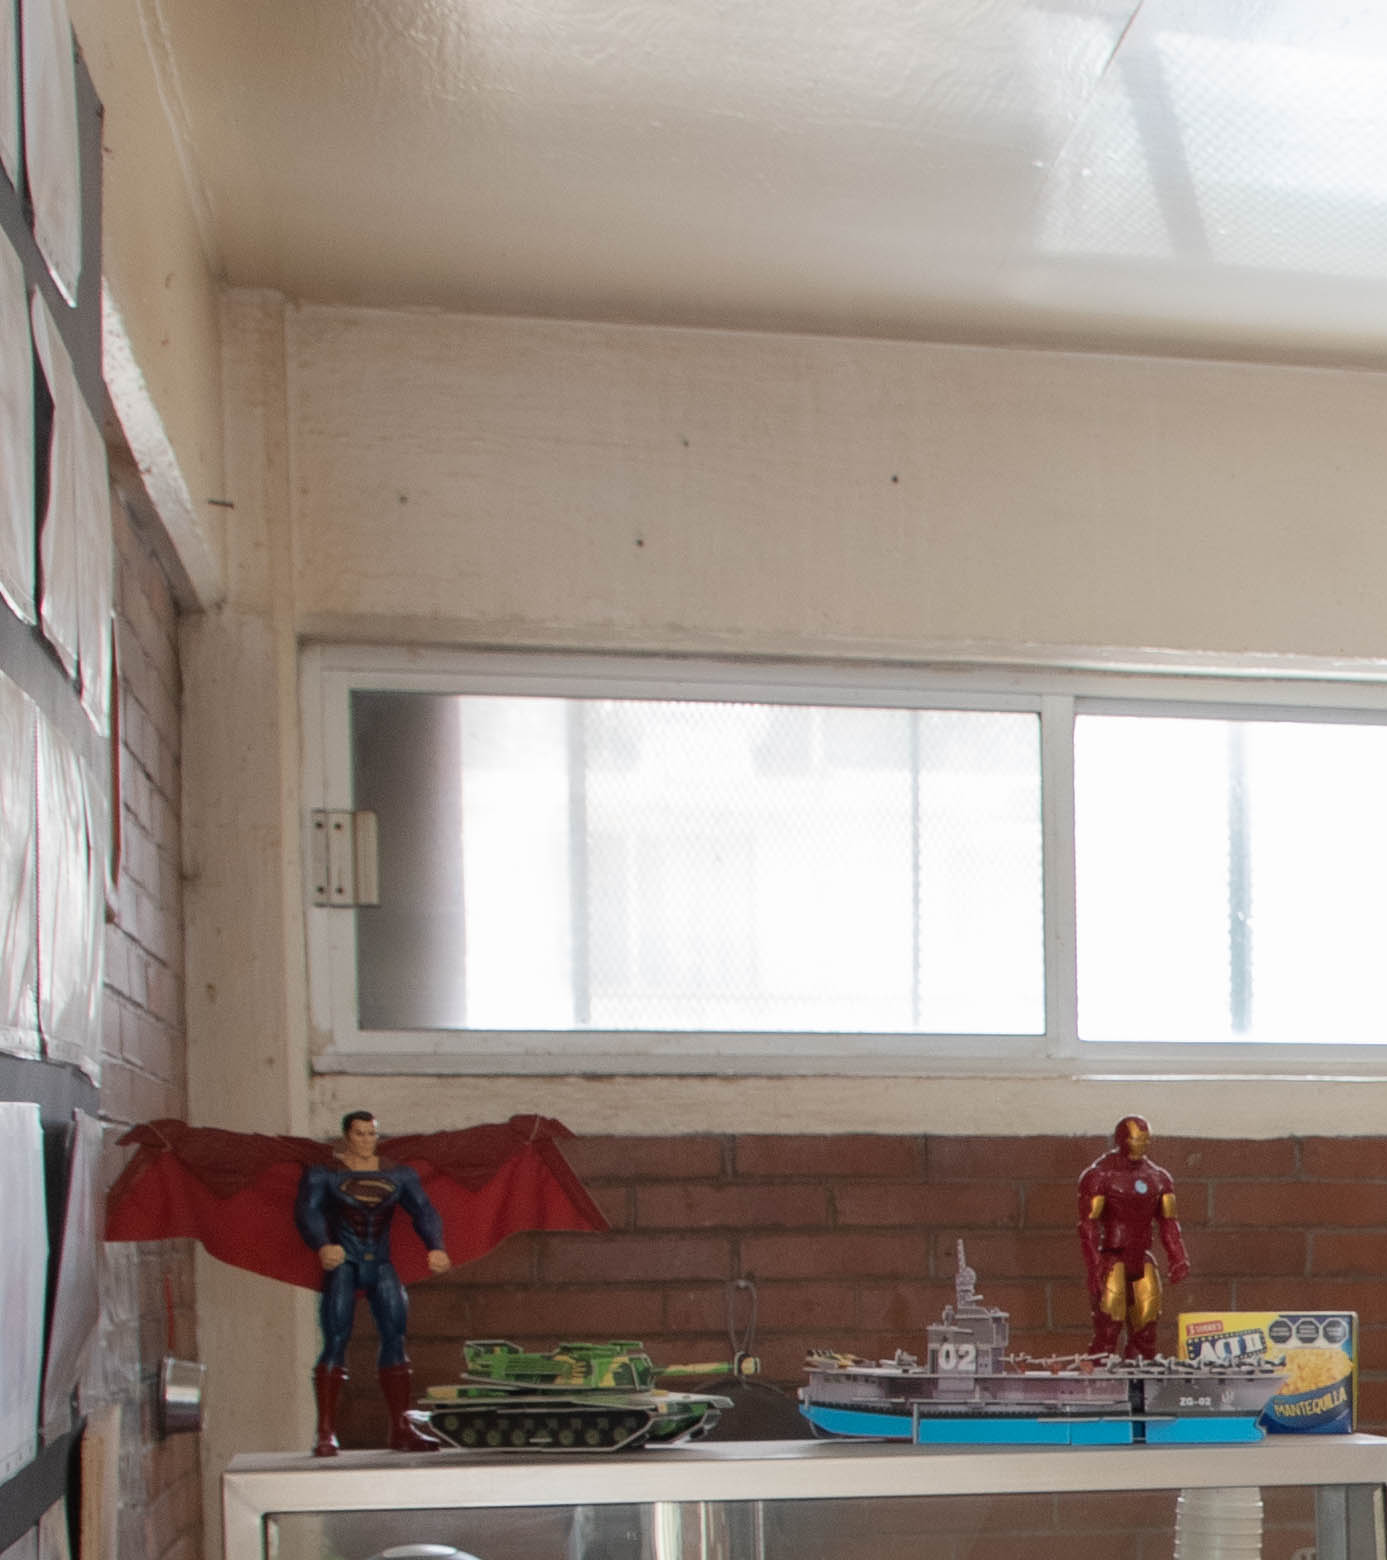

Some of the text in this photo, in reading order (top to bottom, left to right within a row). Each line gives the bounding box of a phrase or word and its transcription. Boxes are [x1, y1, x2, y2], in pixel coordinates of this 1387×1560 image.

[938, 1343, 977, 1371] 02
[1179, 1396, 1212, 1407] ZG-02
[1273, 1386, 1348, 1417] MANTEQUILLA
